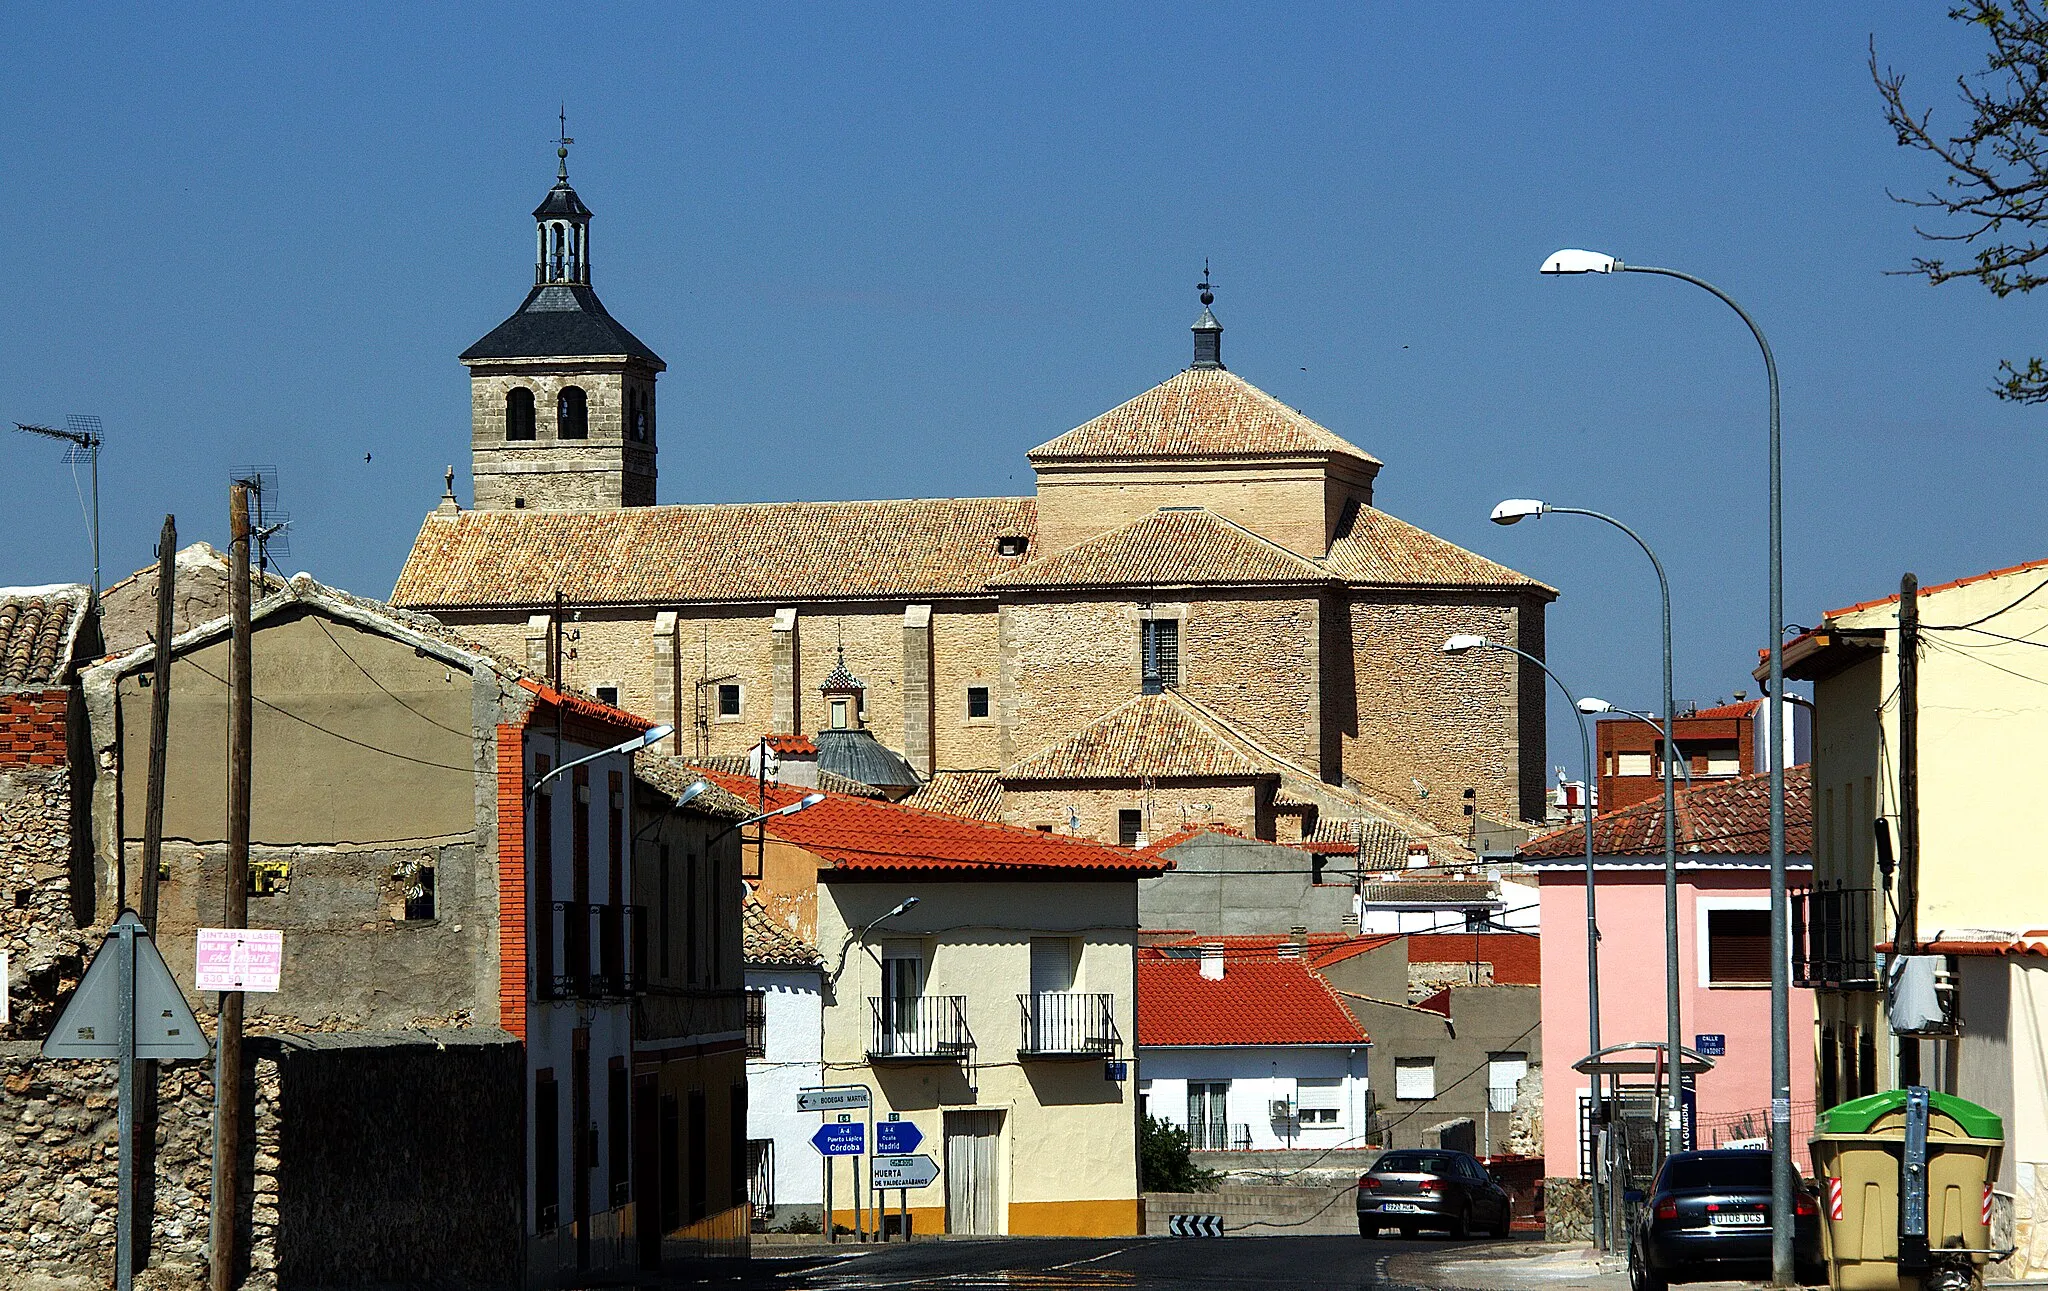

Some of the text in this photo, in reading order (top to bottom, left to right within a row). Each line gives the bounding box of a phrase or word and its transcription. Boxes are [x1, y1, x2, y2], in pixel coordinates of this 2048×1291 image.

[200, 943, 227, 951] DEJE
[820, 1096, 844, 1105] BODEGAS
[1682, 1103, 1690, 1152] LA GUARDIA
[845, 1135, 862, 1143] Lápice
[829, 1143, 860, 1152] Córdoba
[878, 1142, 900, 1150] Madrid
[874, 1169, 901, 1178] HUERTA
